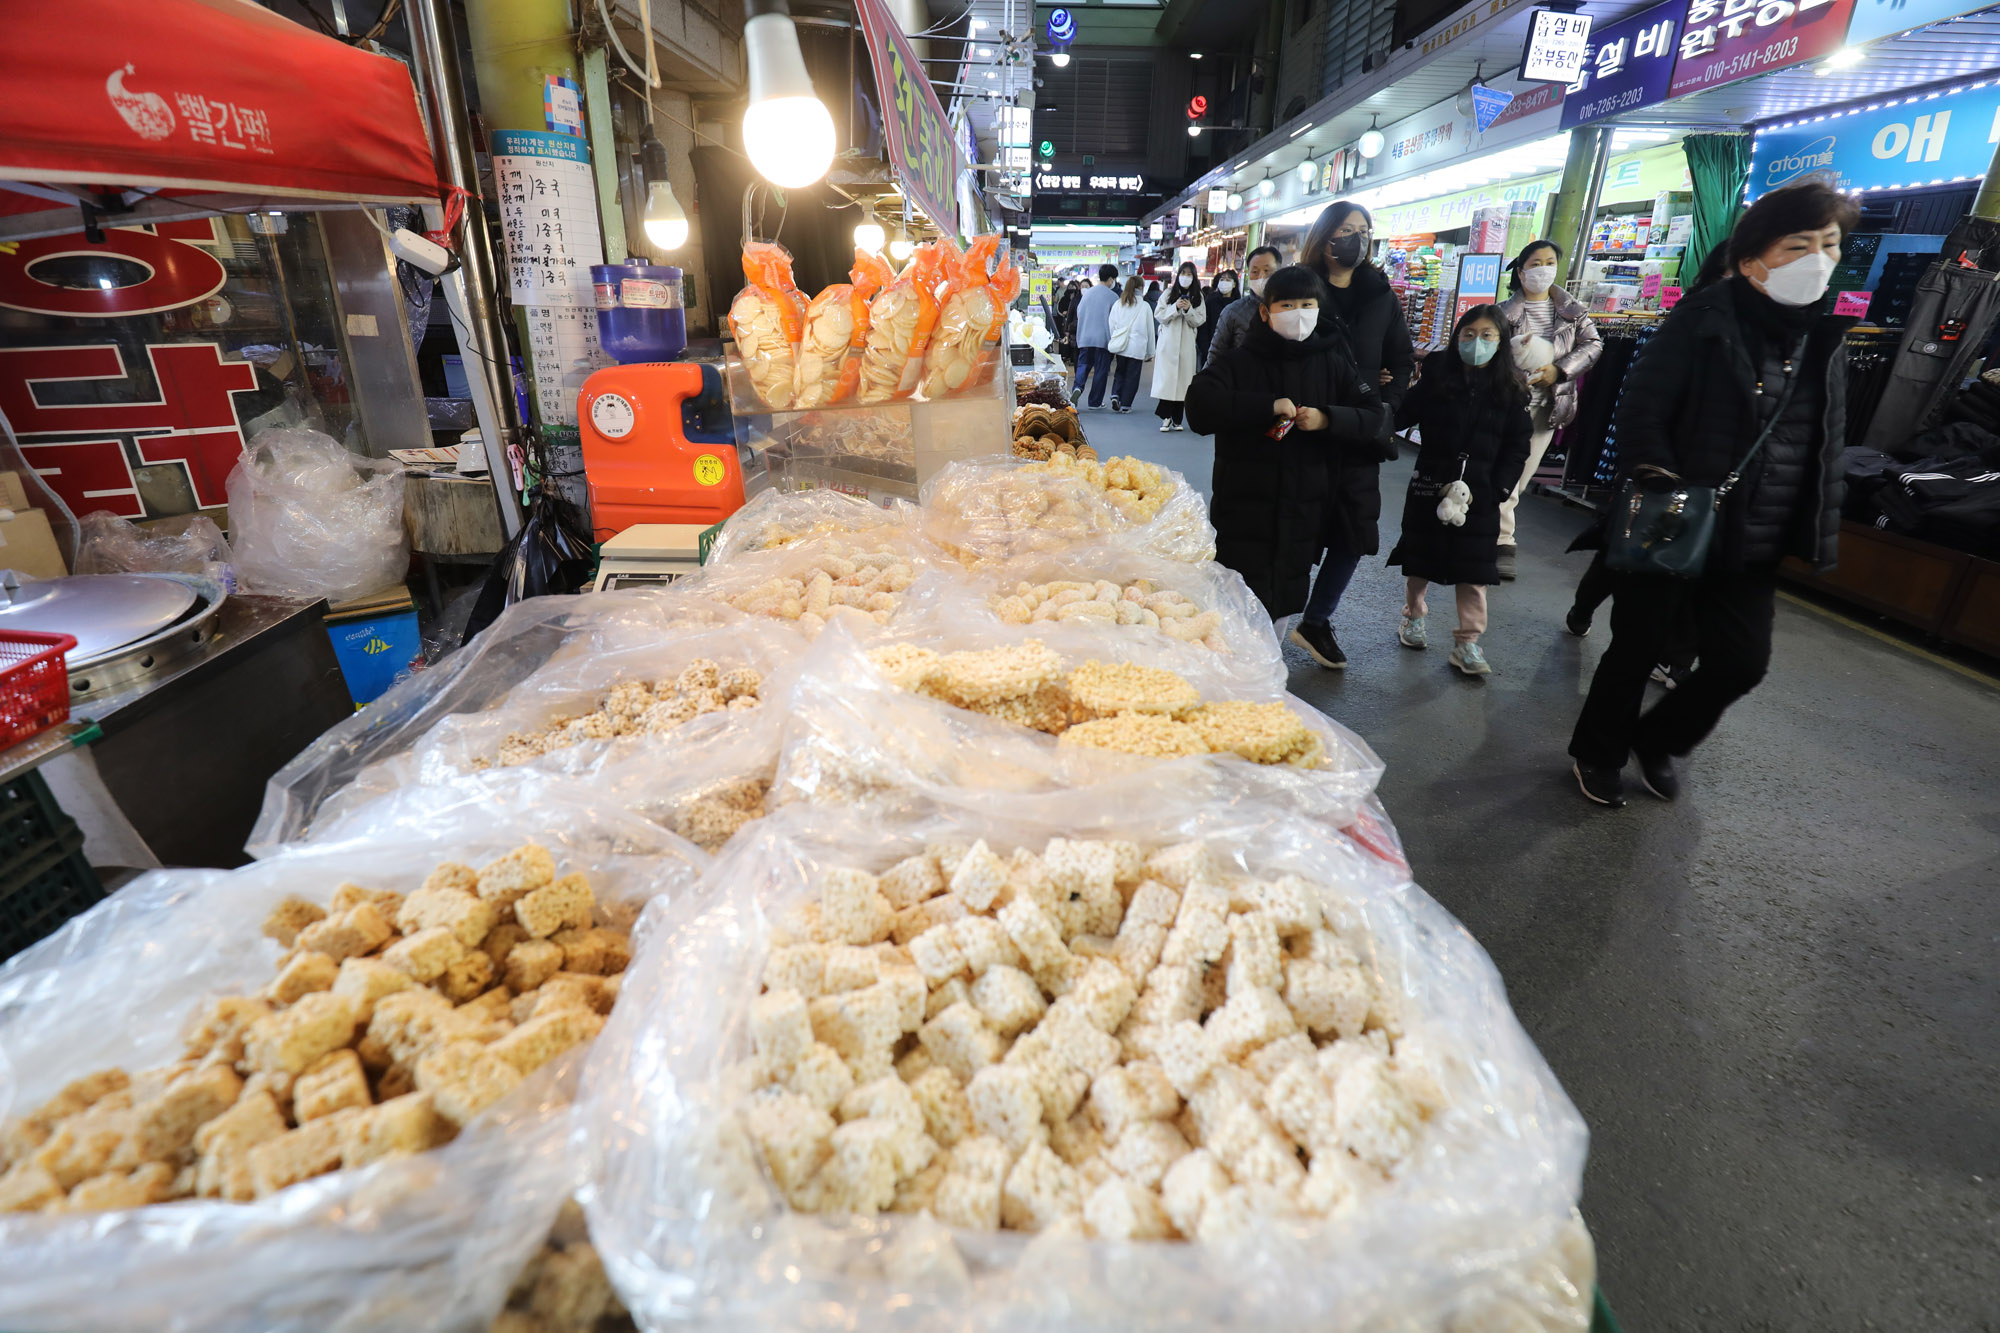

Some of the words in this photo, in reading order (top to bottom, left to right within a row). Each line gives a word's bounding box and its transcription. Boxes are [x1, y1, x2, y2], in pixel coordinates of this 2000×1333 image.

[1544, 49, 1579, 69] 부동산
[1704, 36, 1799, 83] 010-5141-8203
[1478, 101, 1497, 116] 카드
[1579, 86, 1644, 121] 010-7265-2203
[1390, 205, 1431, 234] 정성을
[1439, 192, 1492, 222] 다하는
